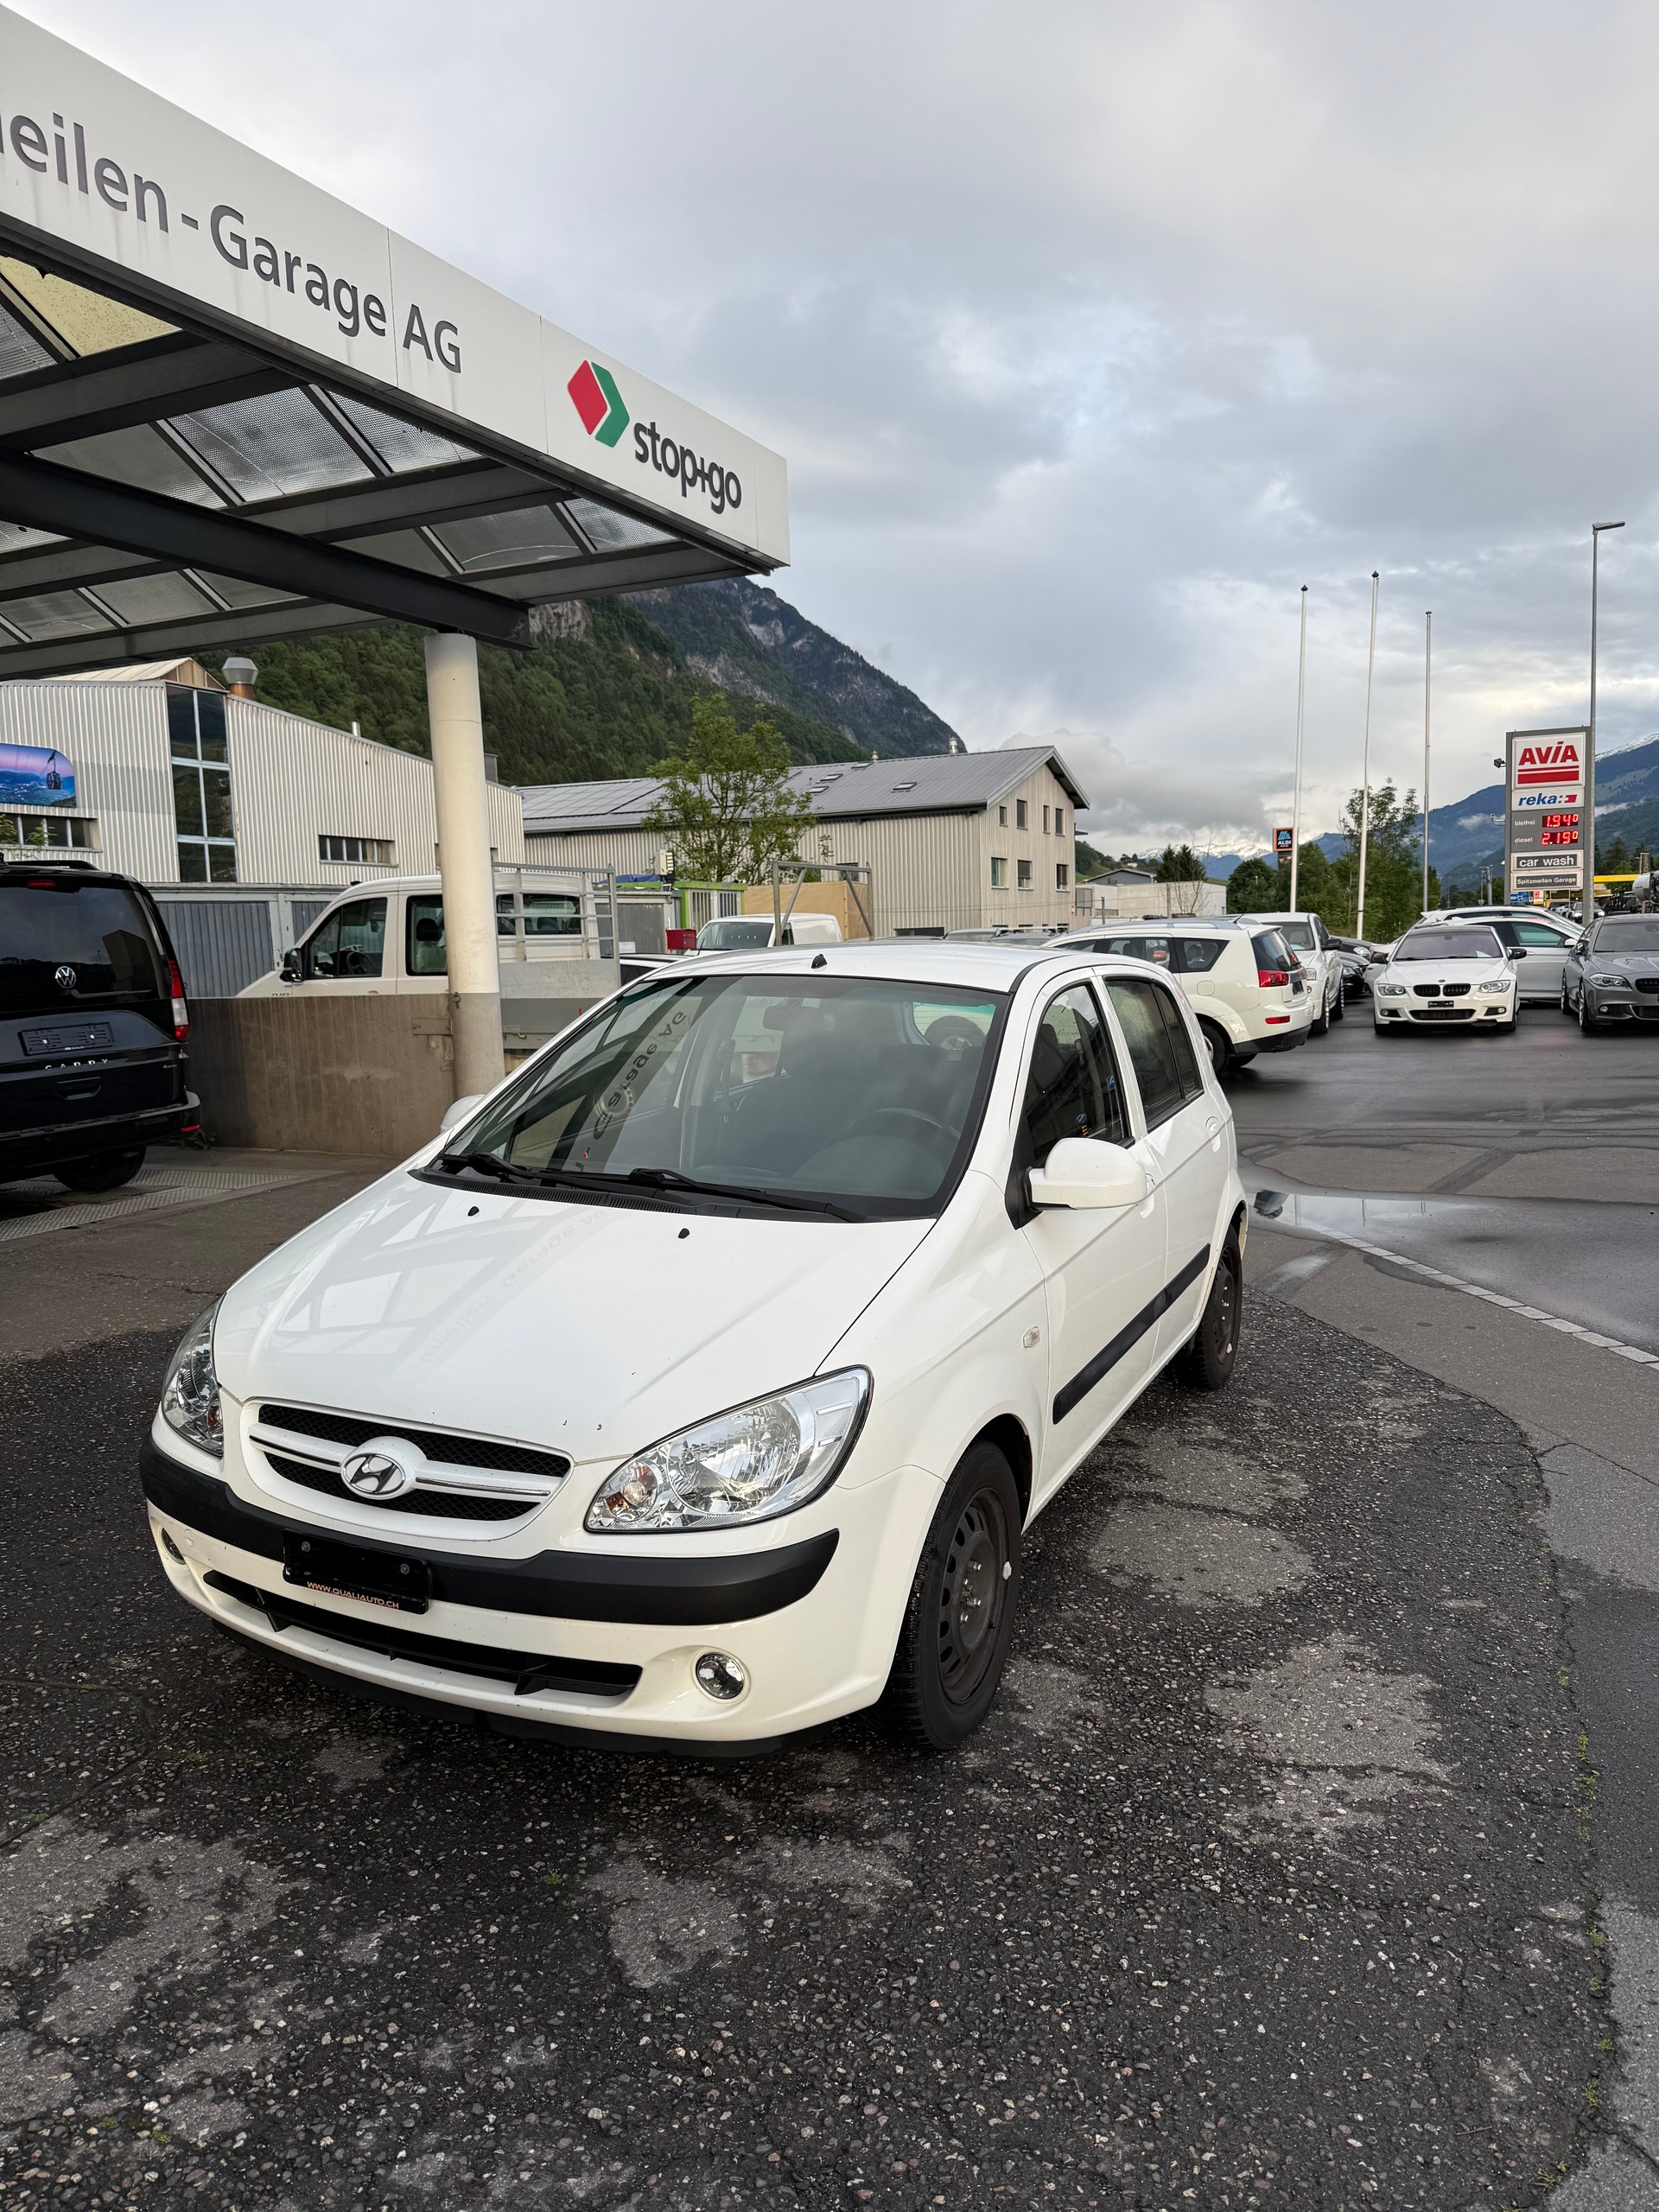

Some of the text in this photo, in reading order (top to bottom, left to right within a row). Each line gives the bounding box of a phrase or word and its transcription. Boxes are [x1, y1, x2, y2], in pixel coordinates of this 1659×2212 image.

[402, 303, 461, 374] AG
[633, 421, 742, 515] stop+go
[1518, 741, 1580, 766] AVIA
[1519, 855, 1574, 868] car wash
[1516, 877, 1553, 886] Spitzmeilen
[307, 1581, 399, 1610] WWW.QUALIAUTO.CH
